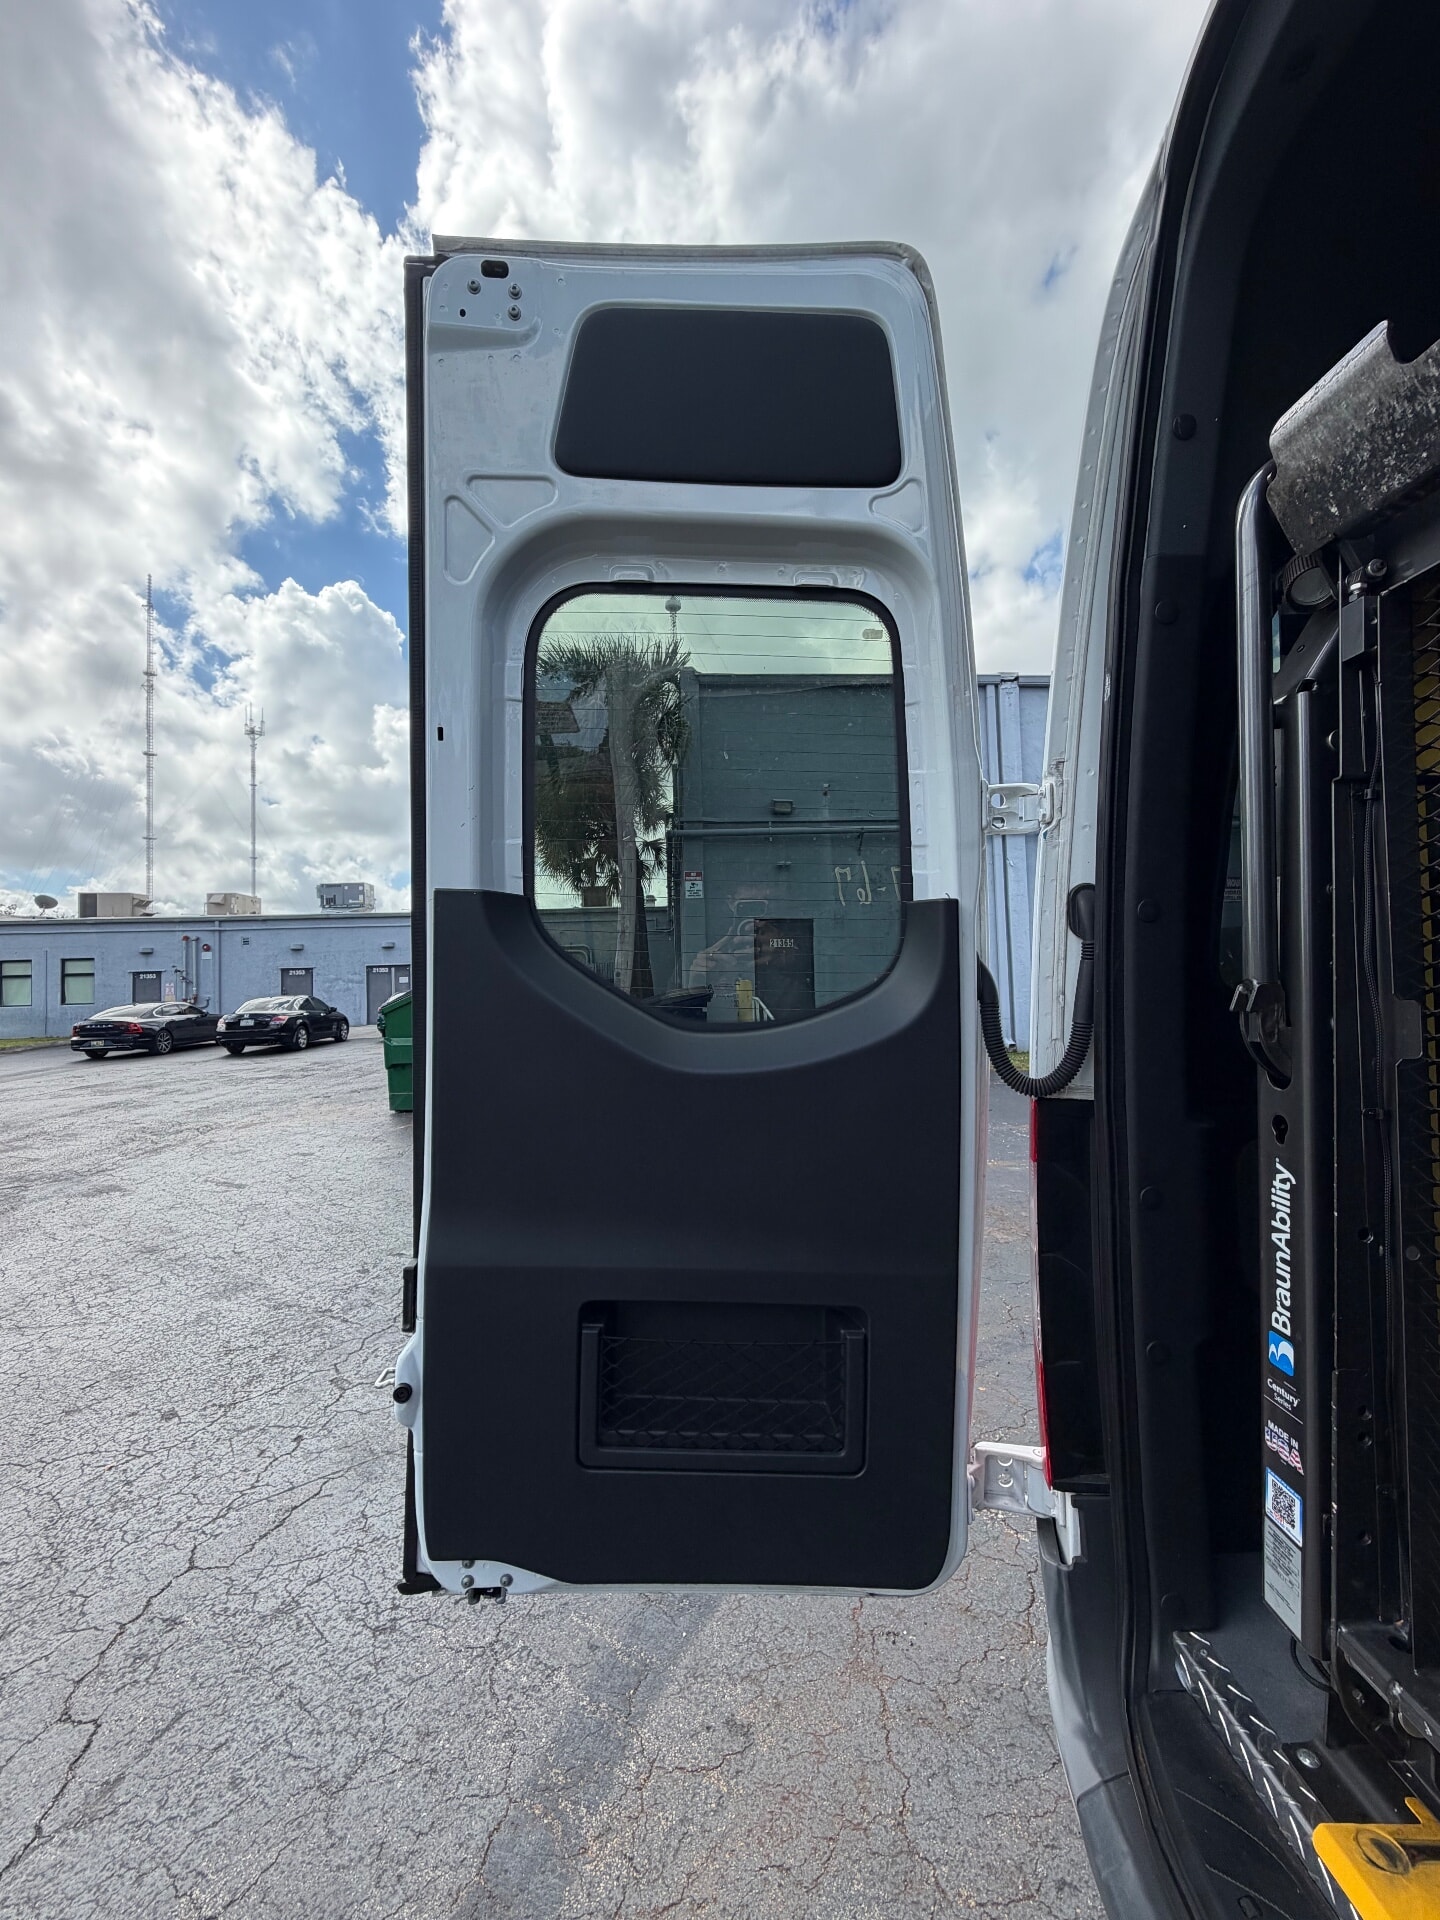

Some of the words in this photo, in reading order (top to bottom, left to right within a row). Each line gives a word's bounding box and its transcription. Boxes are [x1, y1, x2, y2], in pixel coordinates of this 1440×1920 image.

[770, 939, 793, 947] 21365
[1271, 1163, 1296, 1336] BraunAbility
[1267, 1378, 1299, 1407] Century
[1273, 1393, 1292, 1411] Series
[1267, 1419, 1290, 1442] MADE
[1290, 1437, 1299, 1450] IN
[1264, 1426, 1304, 1475] USA
